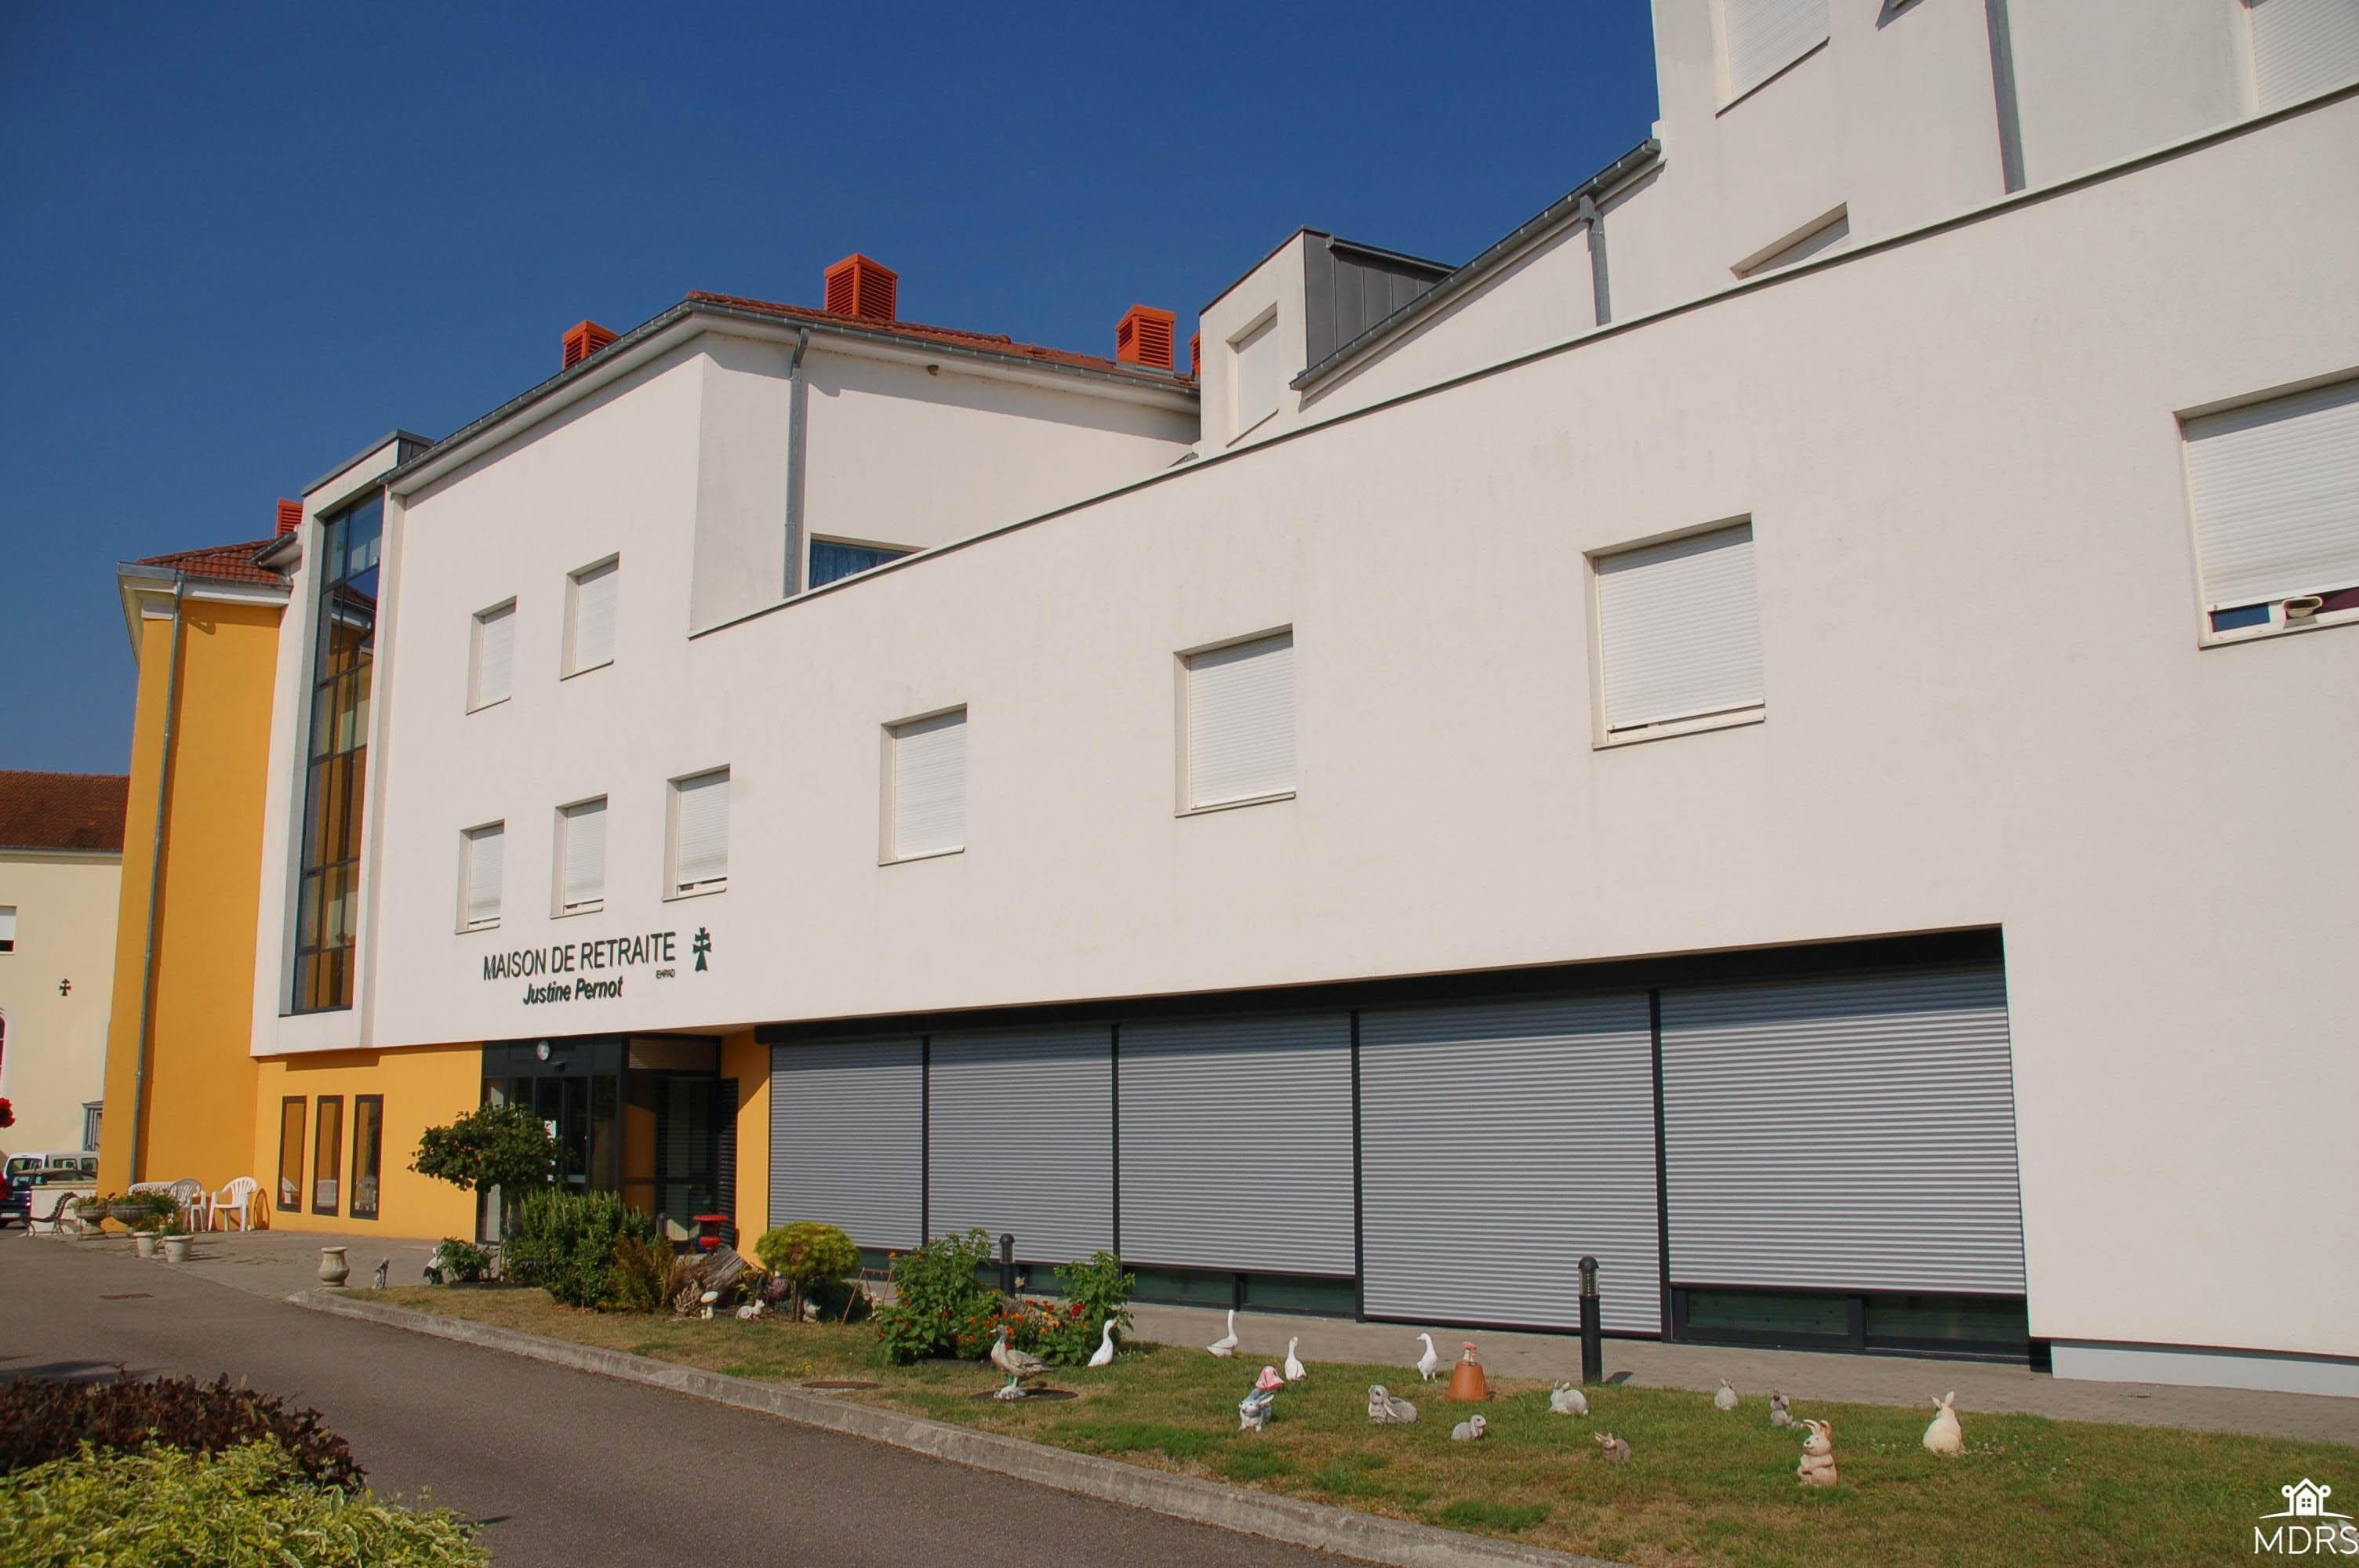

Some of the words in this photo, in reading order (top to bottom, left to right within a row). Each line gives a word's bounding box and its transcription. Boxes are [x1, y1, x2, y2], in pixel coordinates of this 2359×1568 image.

[484, 949, 546, 980] MAISON
[552, 946, 575, 973] DE
[581, 932, 676, 969] RETRAITE
[523, 981, 571, 1004] Justine
[576, 976, 623, 1000] Pernot
